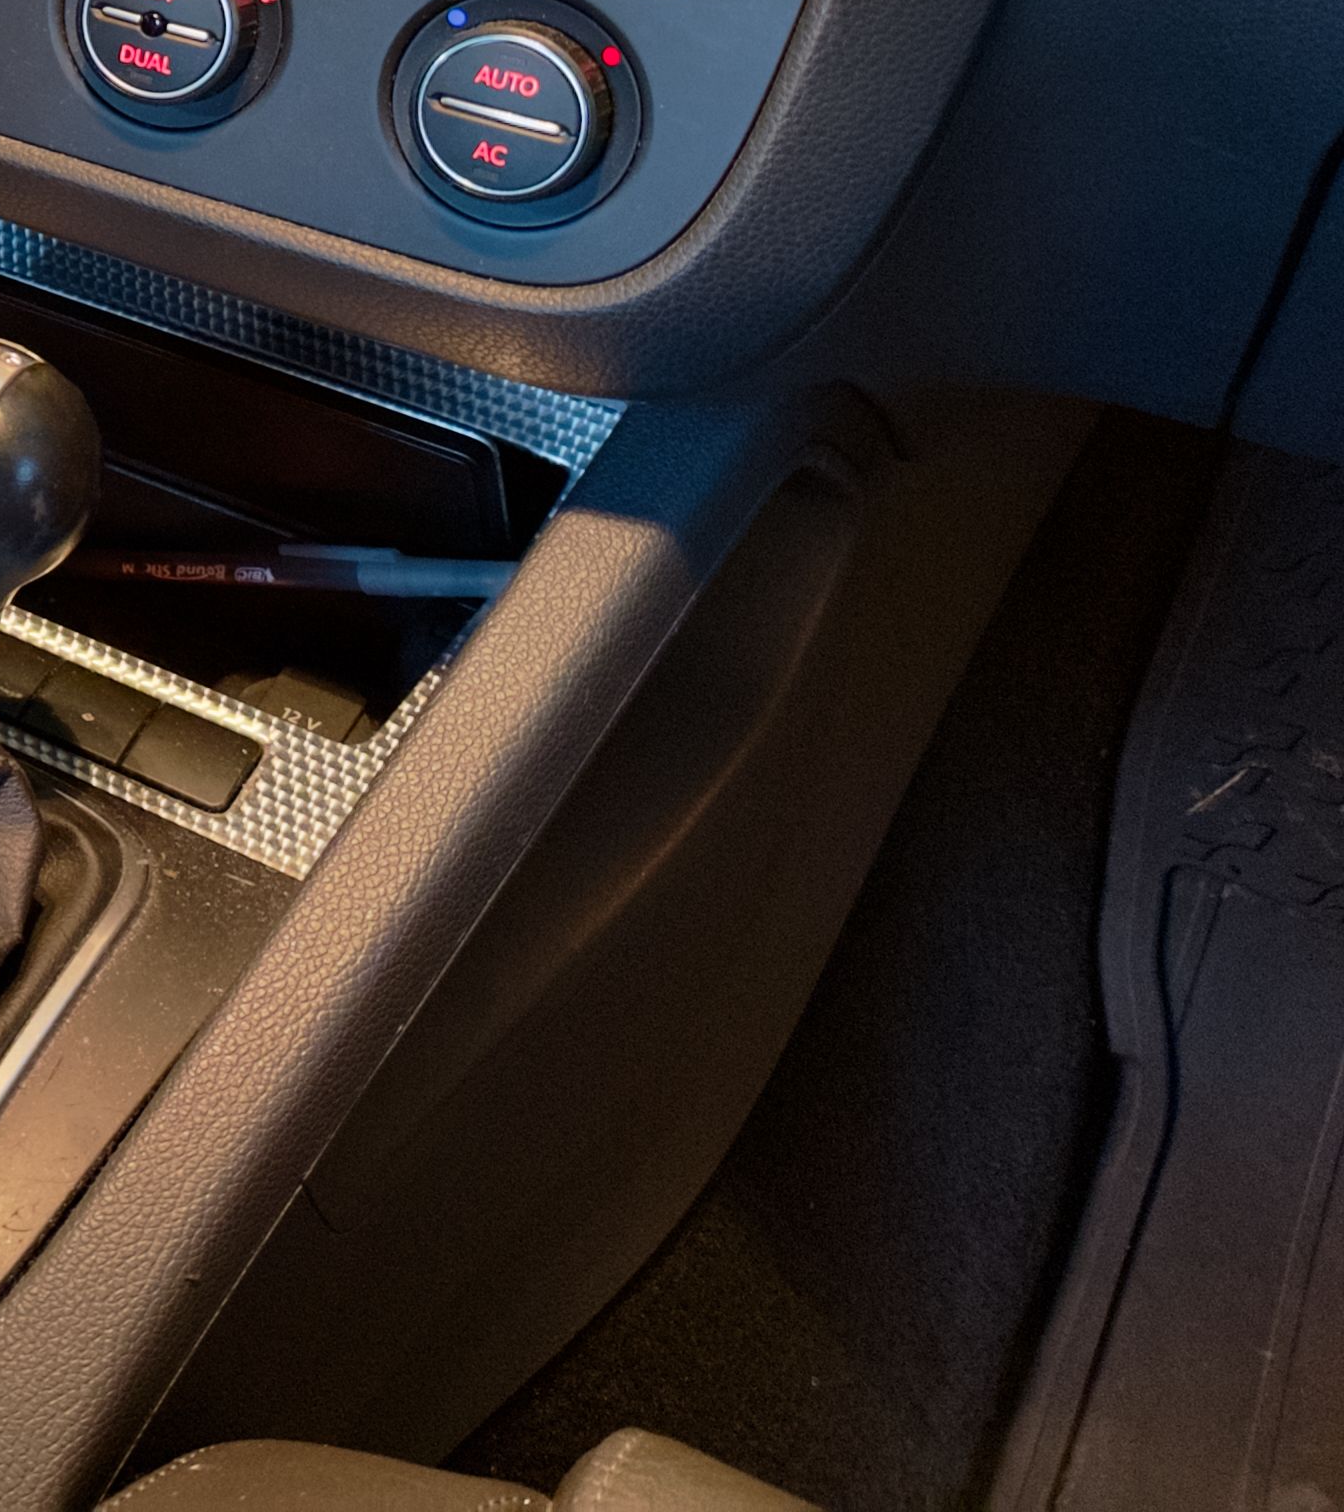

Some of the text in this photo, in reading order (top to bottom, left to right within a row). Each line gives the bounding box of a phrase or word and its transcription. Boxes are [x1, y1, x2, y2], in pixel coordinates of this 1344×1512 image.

[118, 44, 171, 76] DUAL
[473, 64, 541, 99] AUTO
[473, 141, 507, 167] AC
[175, 563, 226, 580] Round
[281, 707, 323, 731] 12 V
